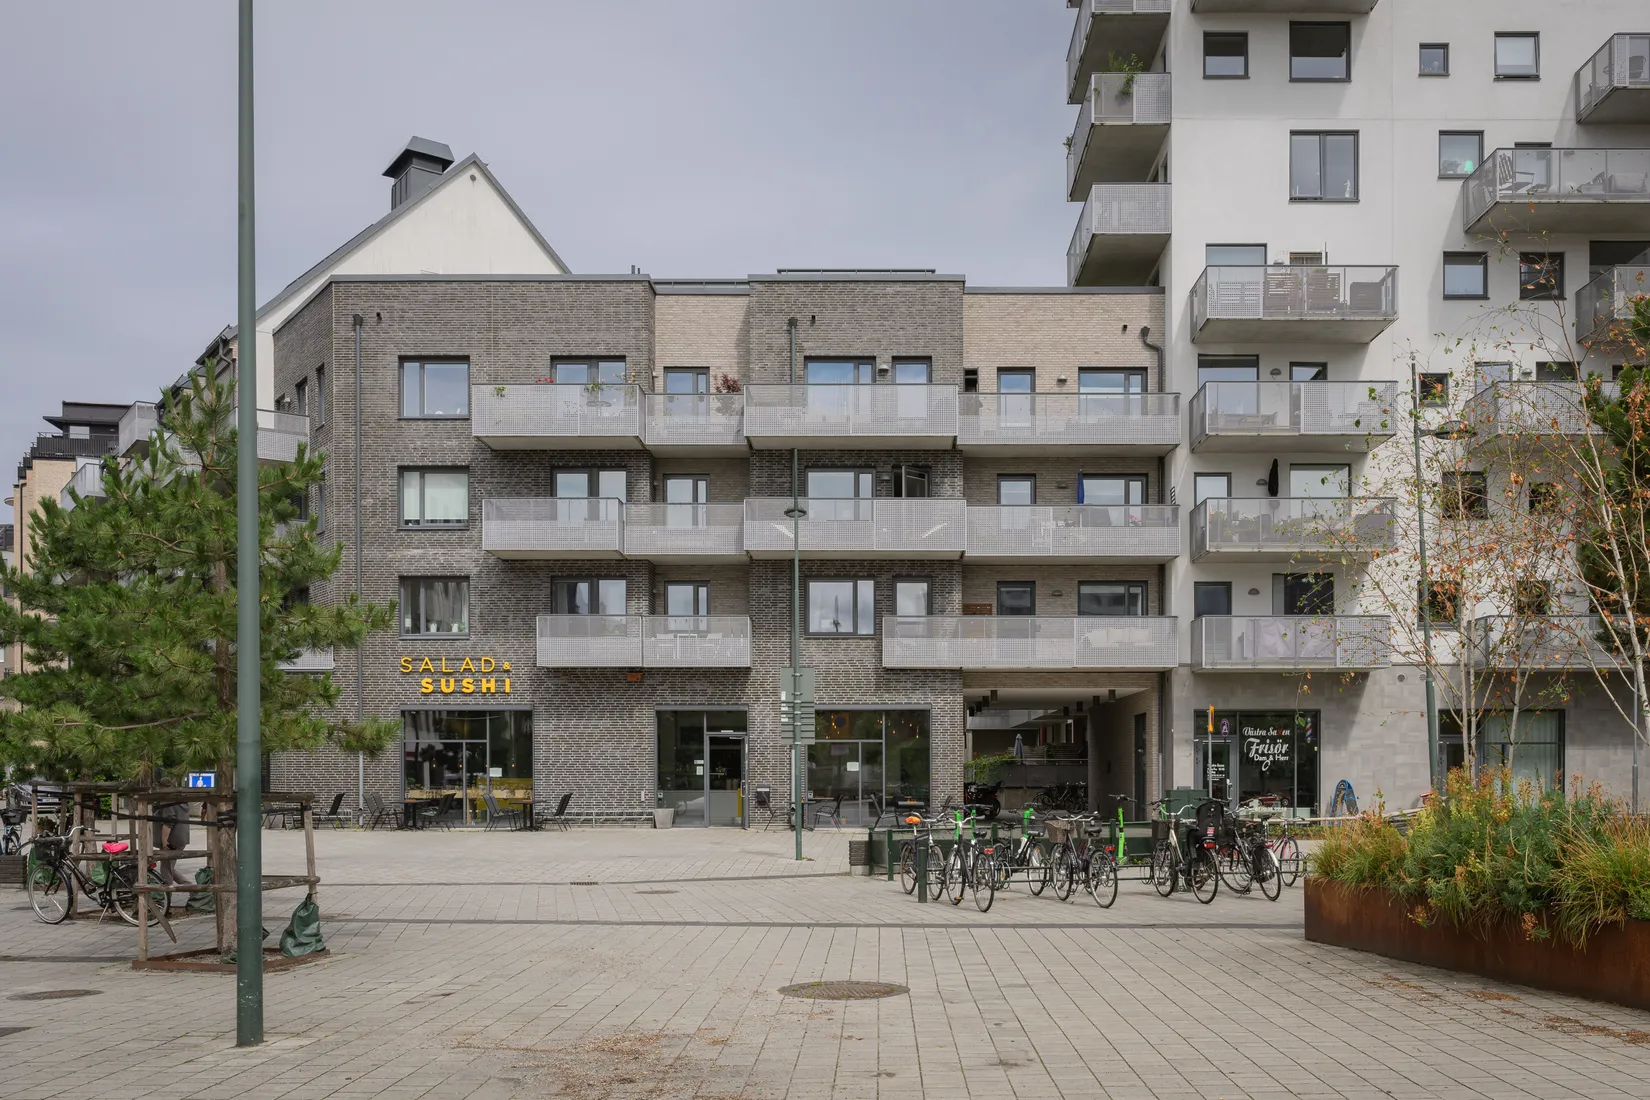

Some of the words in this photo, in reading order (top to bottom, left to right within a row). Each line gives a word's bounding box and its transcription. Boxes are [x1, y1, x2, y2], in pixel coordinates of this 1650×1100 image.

[400, 656, 495, 673] SALAD
[503, 661, 511, 670] &
[421, 678, 511, 693] SUSHI
[1242, 727, 1266, 735] Västra
[1244, 738, 1289, 757] Frisör
